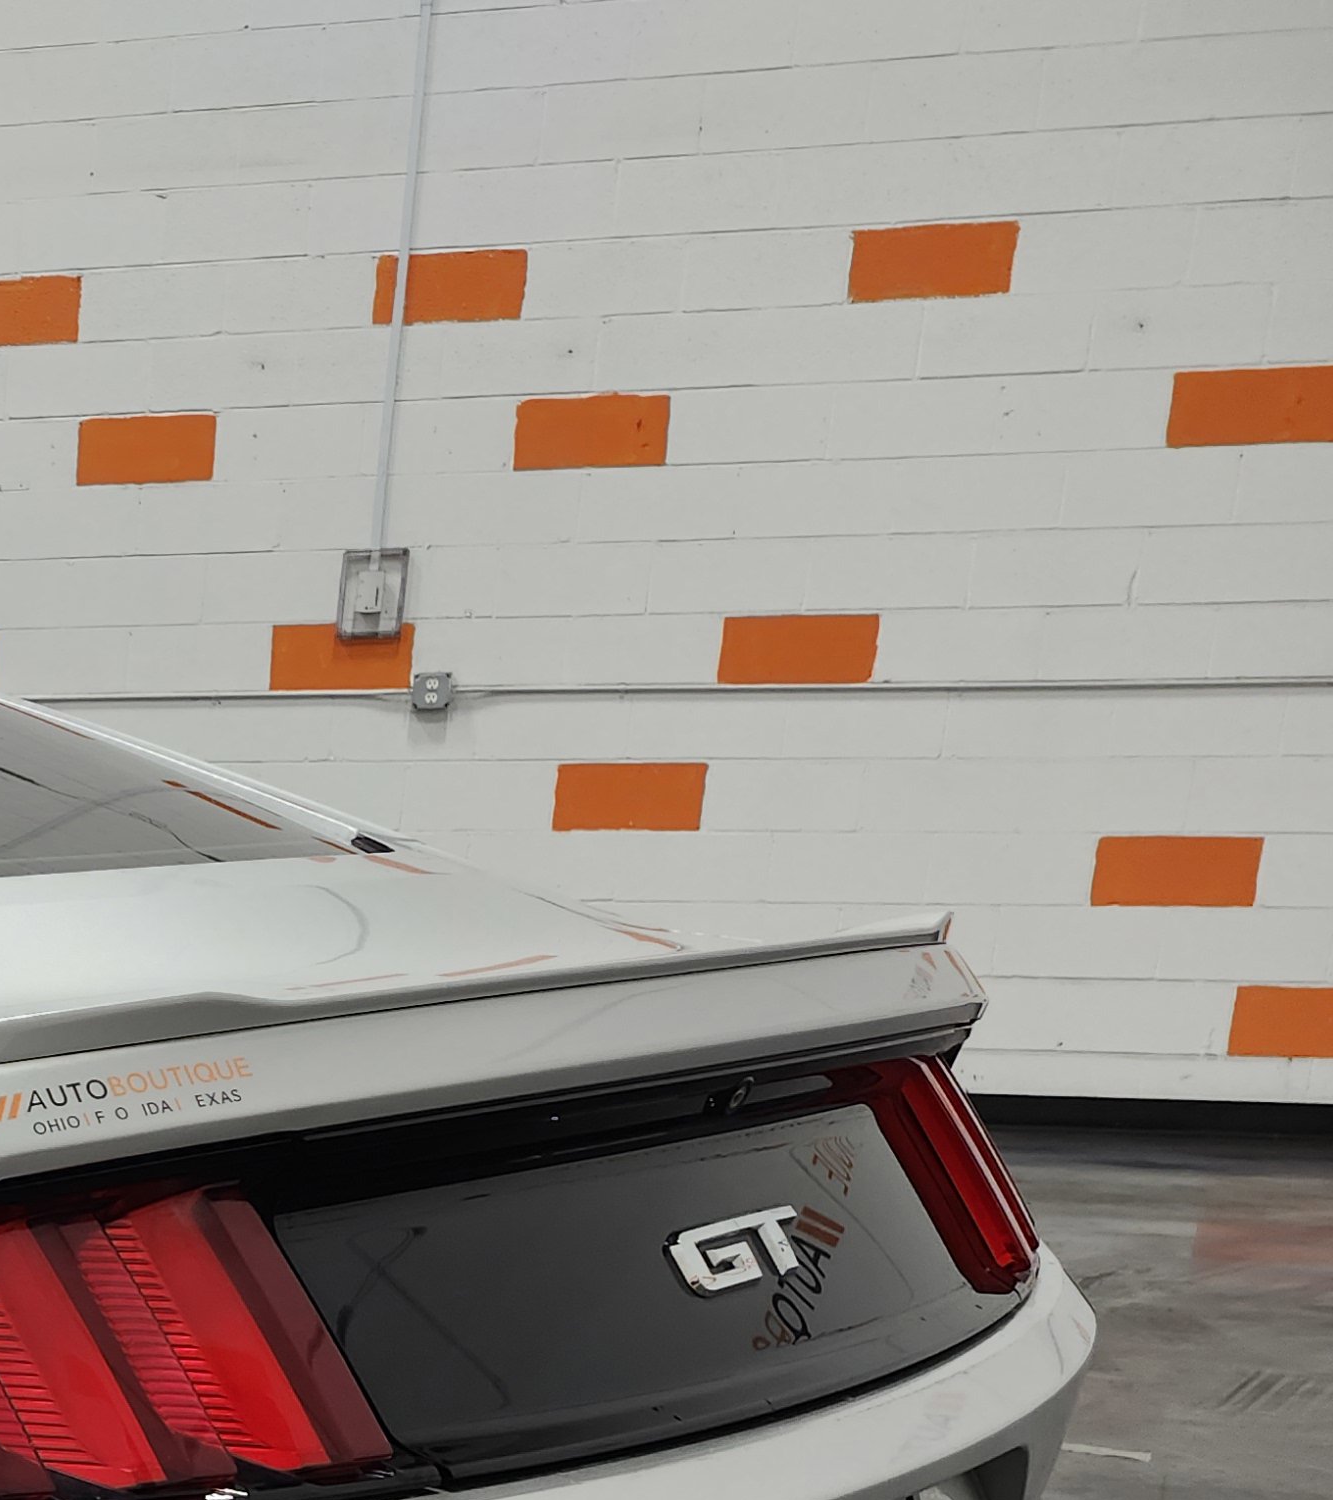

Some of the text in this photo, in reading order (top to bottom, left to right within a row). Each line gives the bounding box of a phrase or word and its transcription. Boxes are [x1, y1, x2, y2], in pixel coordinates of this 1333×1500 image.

[27, 1056, 254, 1113] AUTOBOUTIQUE
[32, 1115, 81, 1136] OHIO
[661, 1204, 799, 1300] GT
